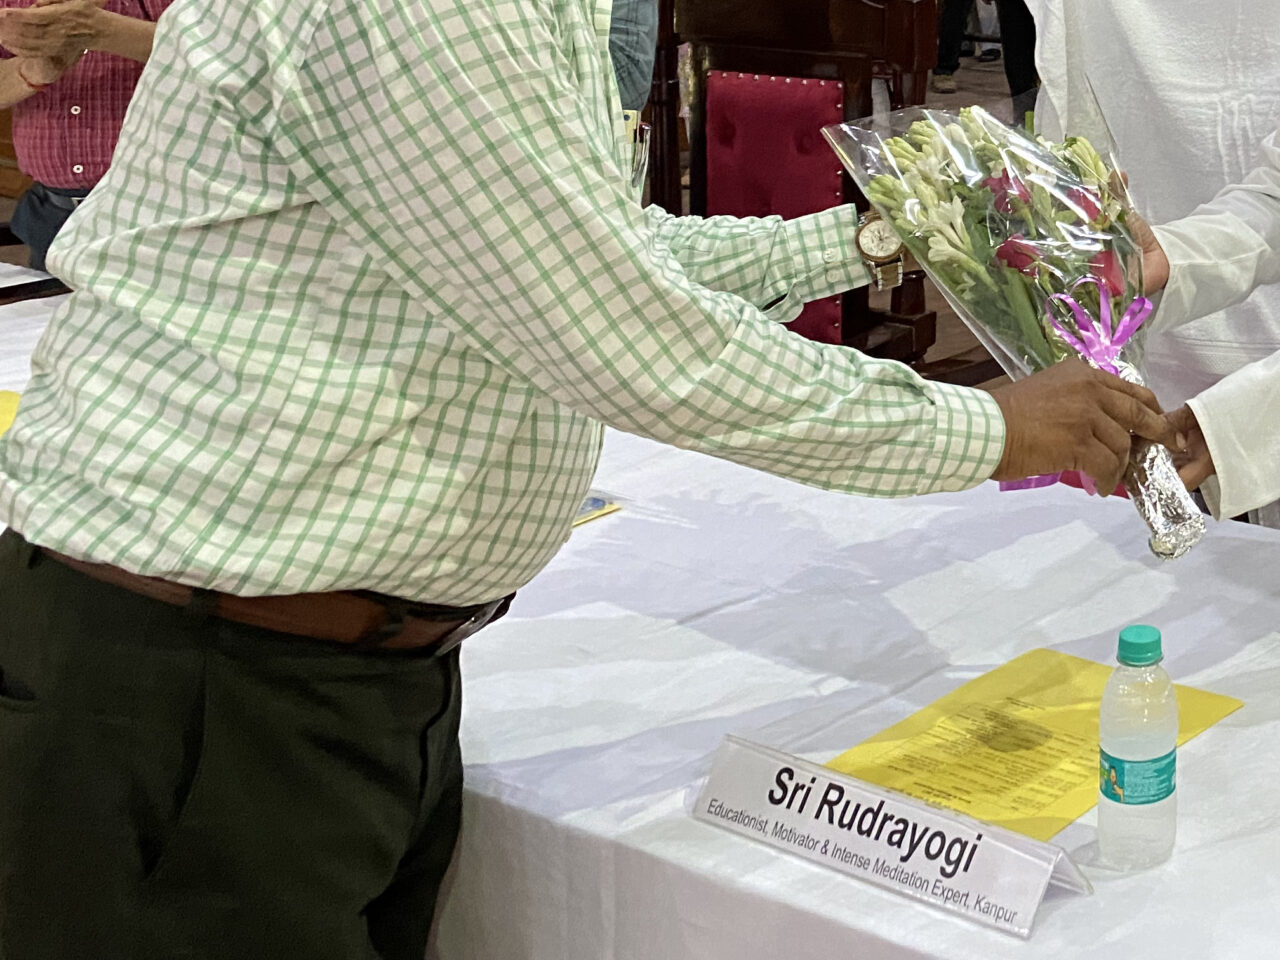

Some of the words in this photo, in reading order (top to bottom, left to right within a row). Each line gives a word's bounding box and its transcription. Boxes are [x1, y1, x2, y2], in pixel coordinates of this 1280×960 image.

[706, 798, 769, 837] Educationist,
[771, 821, 820, 851] Motivator
[820, 839, 830, 855] &
[831, 842, 871, 871] Intense
[872, 857, 930, 893] Meditation
[931, 879, 970, 909] Expert,
[973, 893, 1018, 924] Kanpur
[768, 767, 817, 815] Sri
[814, 782, 983, 879] Rudrayogi
